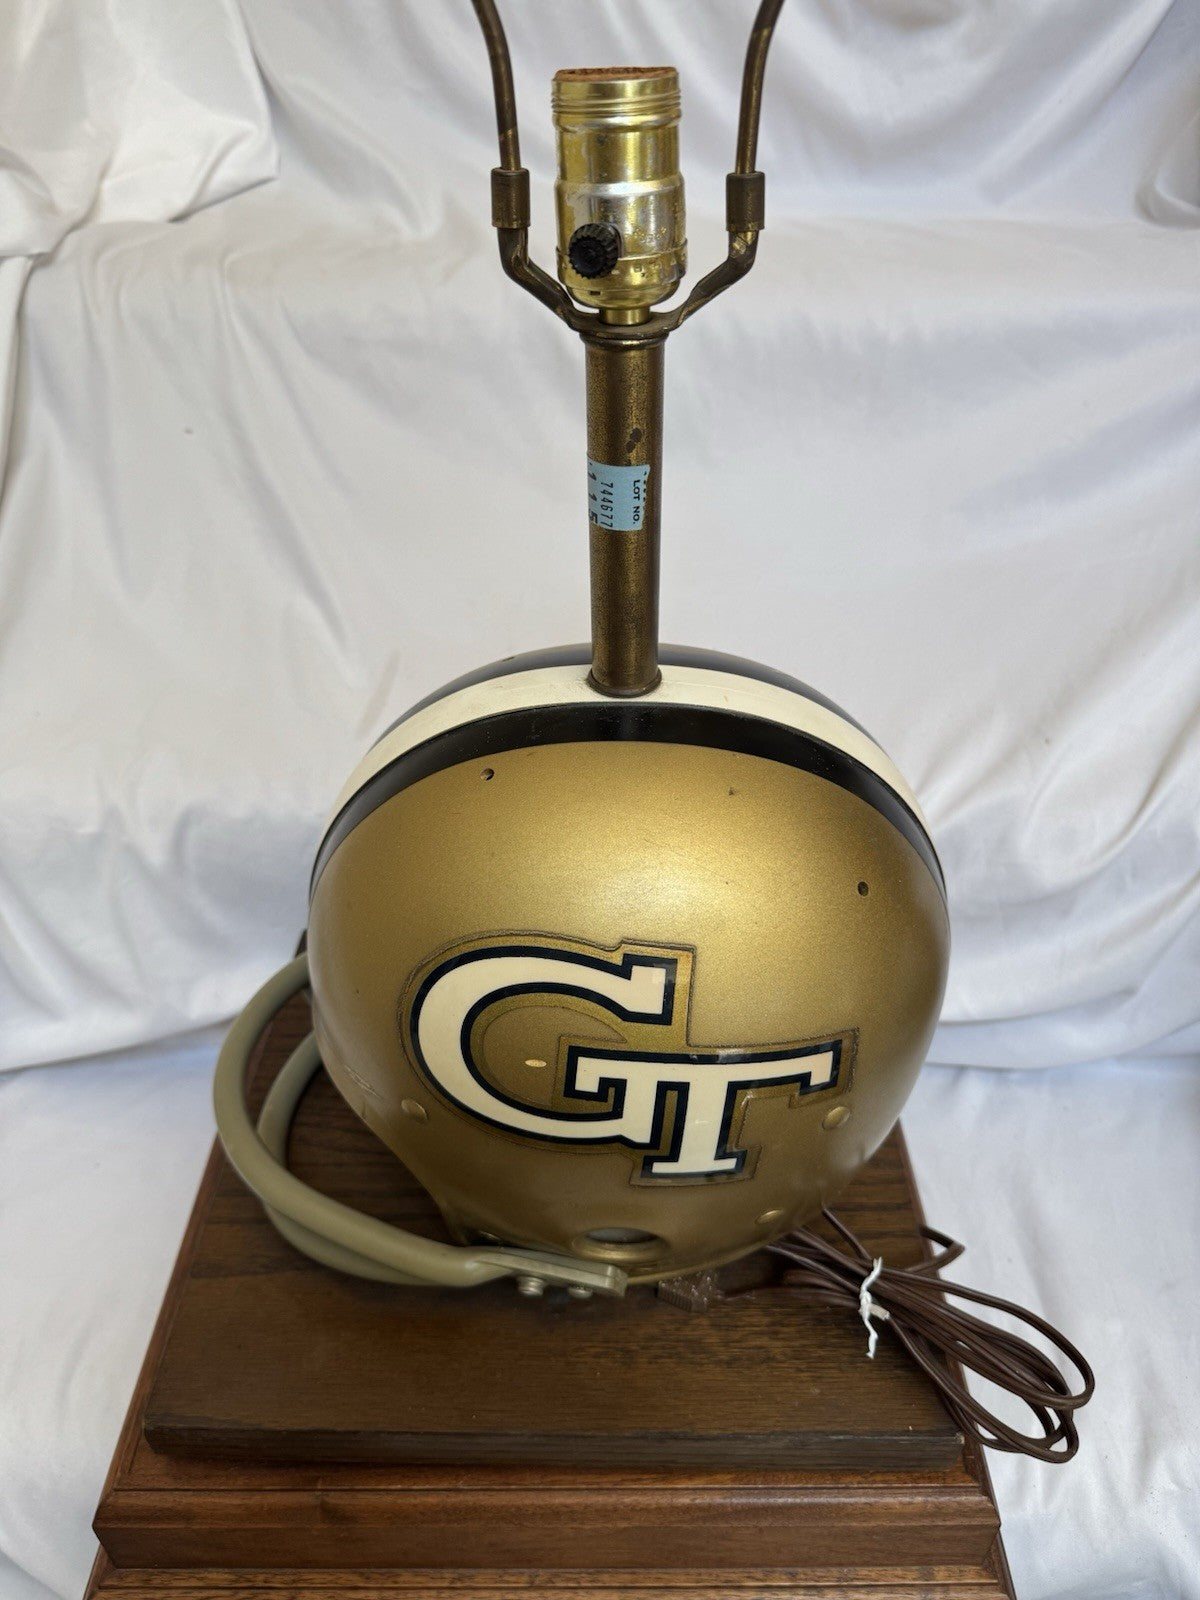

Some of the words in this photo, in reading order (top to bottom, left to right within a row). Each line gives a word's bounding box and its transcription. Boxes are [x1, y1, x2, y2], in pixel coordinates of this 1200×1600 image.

[600, 481, 614, 528] 744677
[633, 479, 641, 501] LOT
[633, 505, 641, 525] NO.
[409, 944, 843, 1179] GT
